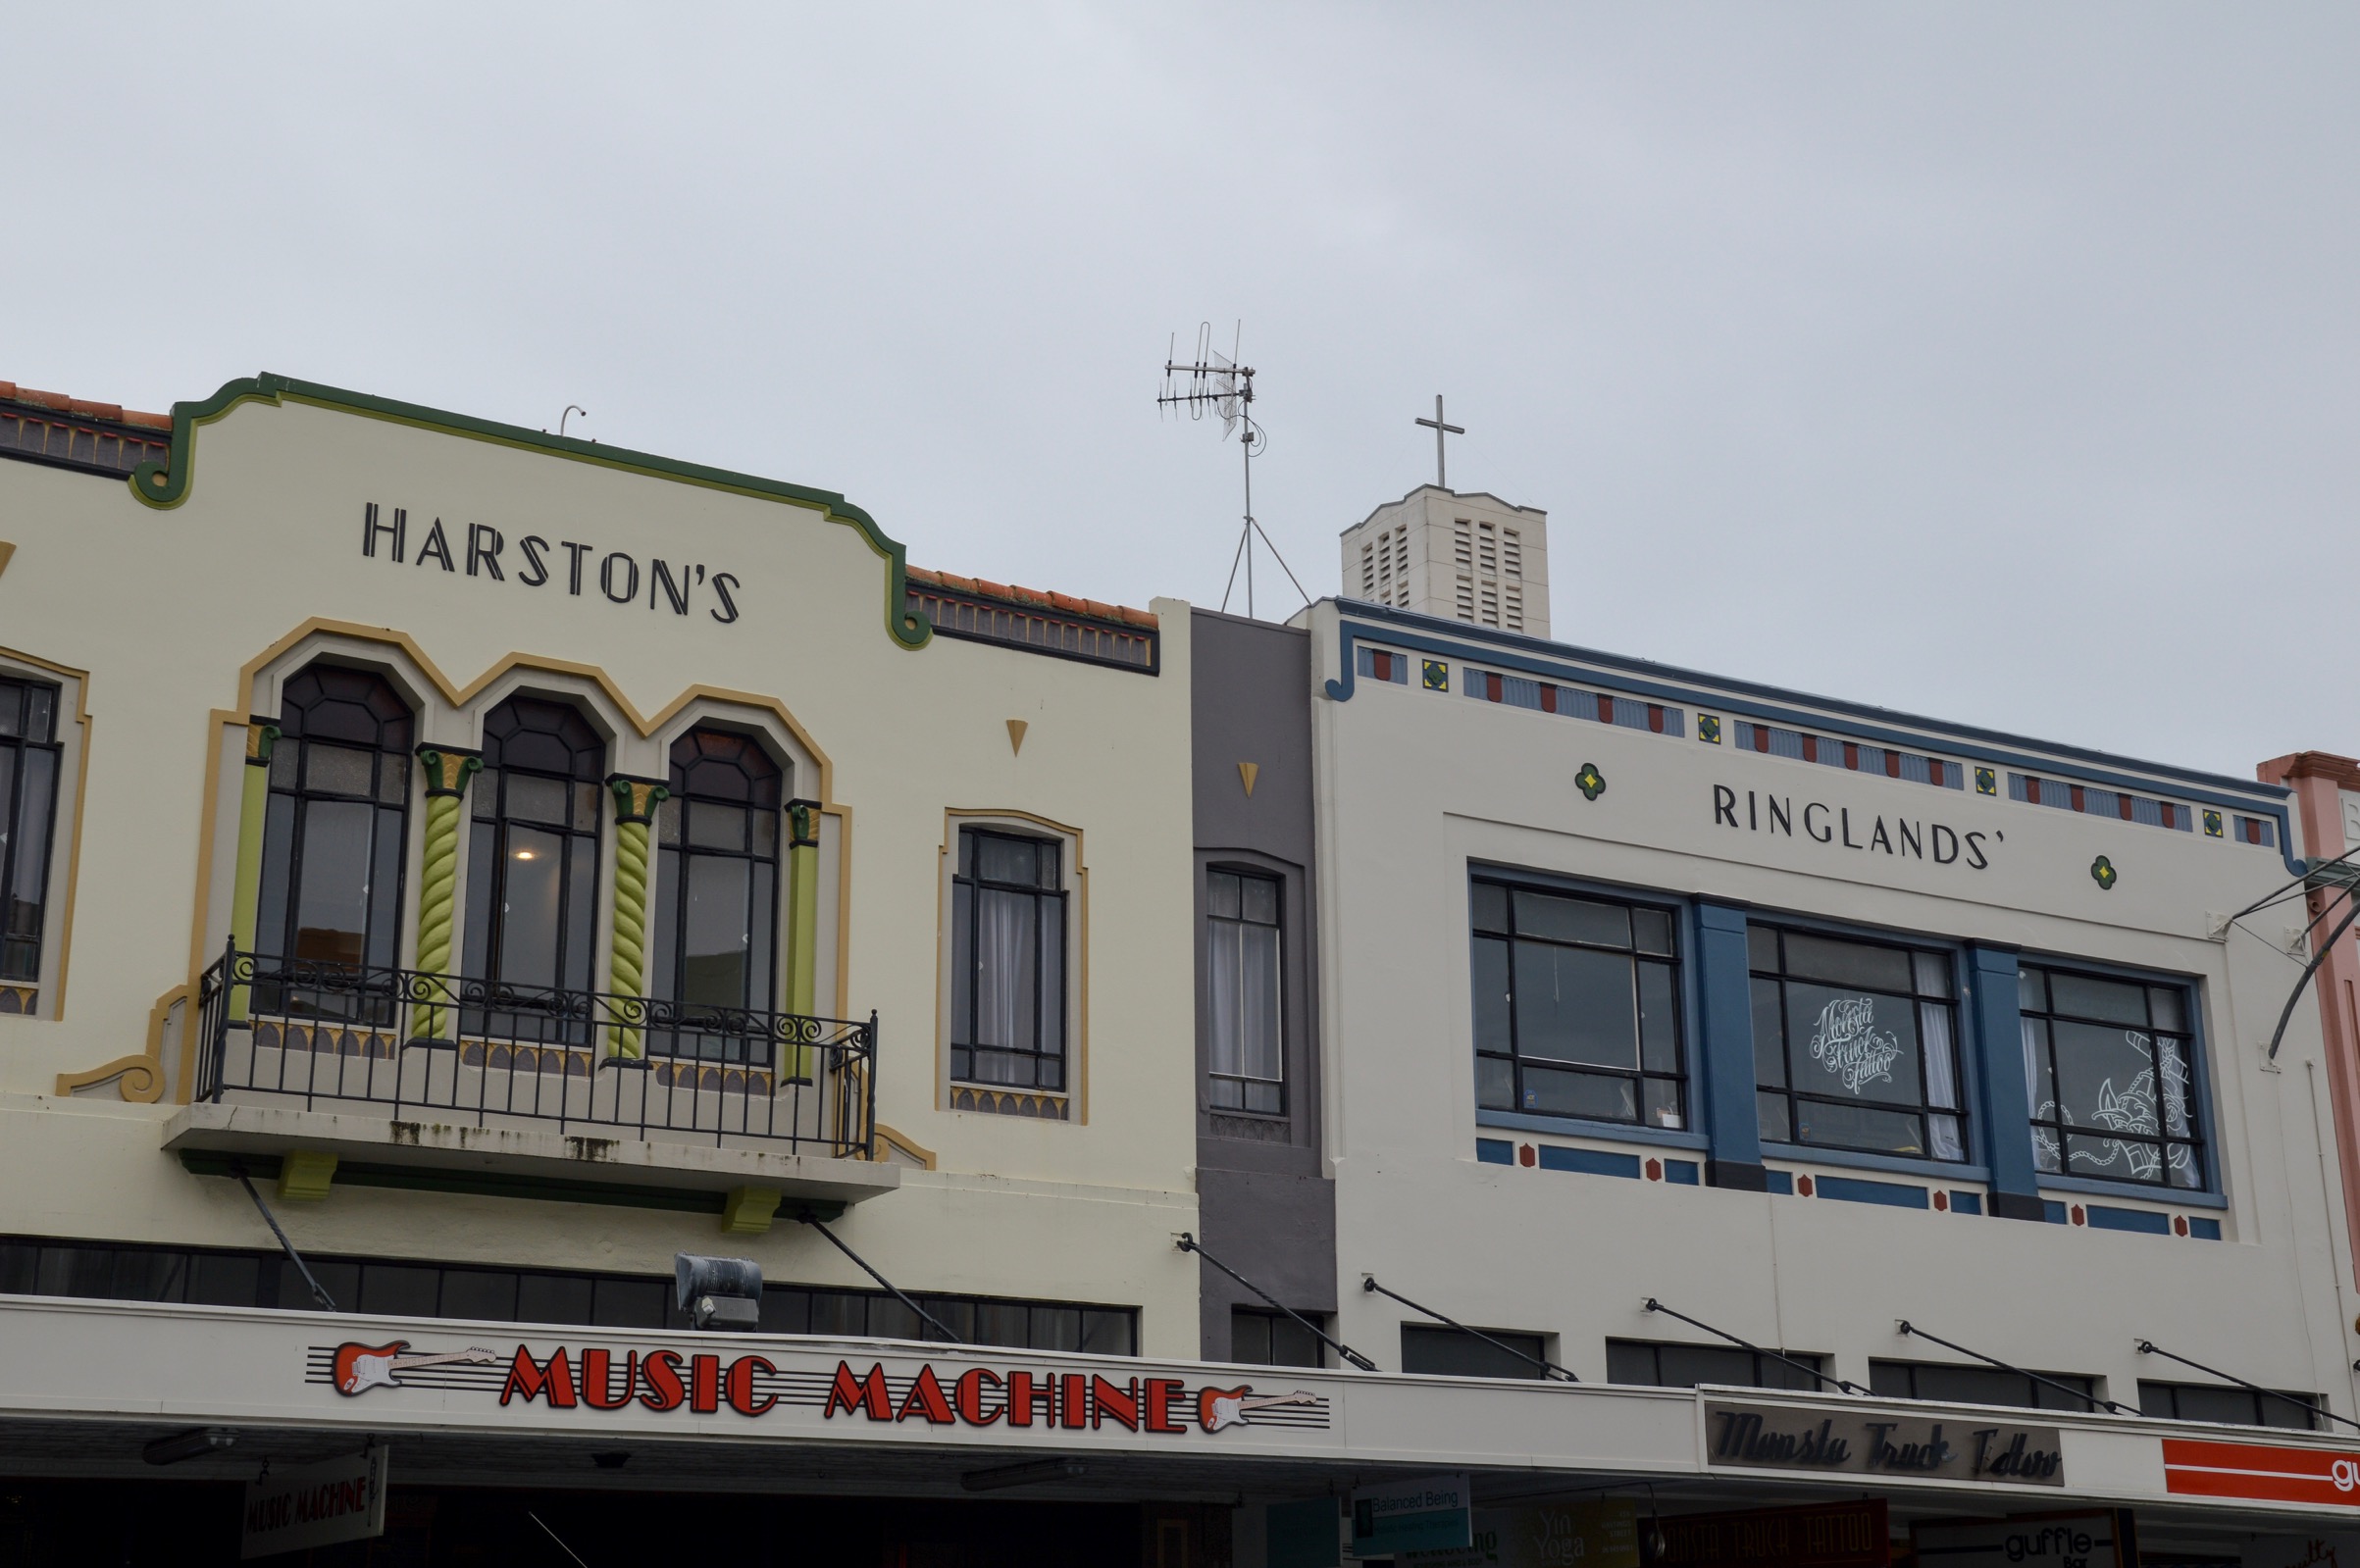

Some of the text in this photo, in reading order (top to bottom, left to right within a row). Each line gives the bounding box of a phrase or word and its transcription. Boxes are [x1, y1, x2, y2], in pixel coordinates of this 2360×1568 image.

[362, 501, 741, 625] HARSTON'S
[1713, 784, 2005, 871] RINGLANDS'
[1823, 1027, 1883, 1073] Truck
[1843, 1046, 1900, 1094] Tattoo
[499, 1343, 1188, 1435] MUSIC MACHINE
[1866, 1422, 1958, 1471] Truck
[246, 1476, 366, 1534] MUSIC MACHINE
[1372, 1490, 1459, 1513] Balanced Being
[1539, 1509, 1570, 1539] Yin
[1532, 1536, 1585, 1567] Yoga
[1731, 1517, 1790, 1559] TRUCK
[1804, 1511, 1873, 1554] TATTOO
[2005, 1527, 2092, 1562] guffle
[2063, 1556, 2088, 1568] Bar
